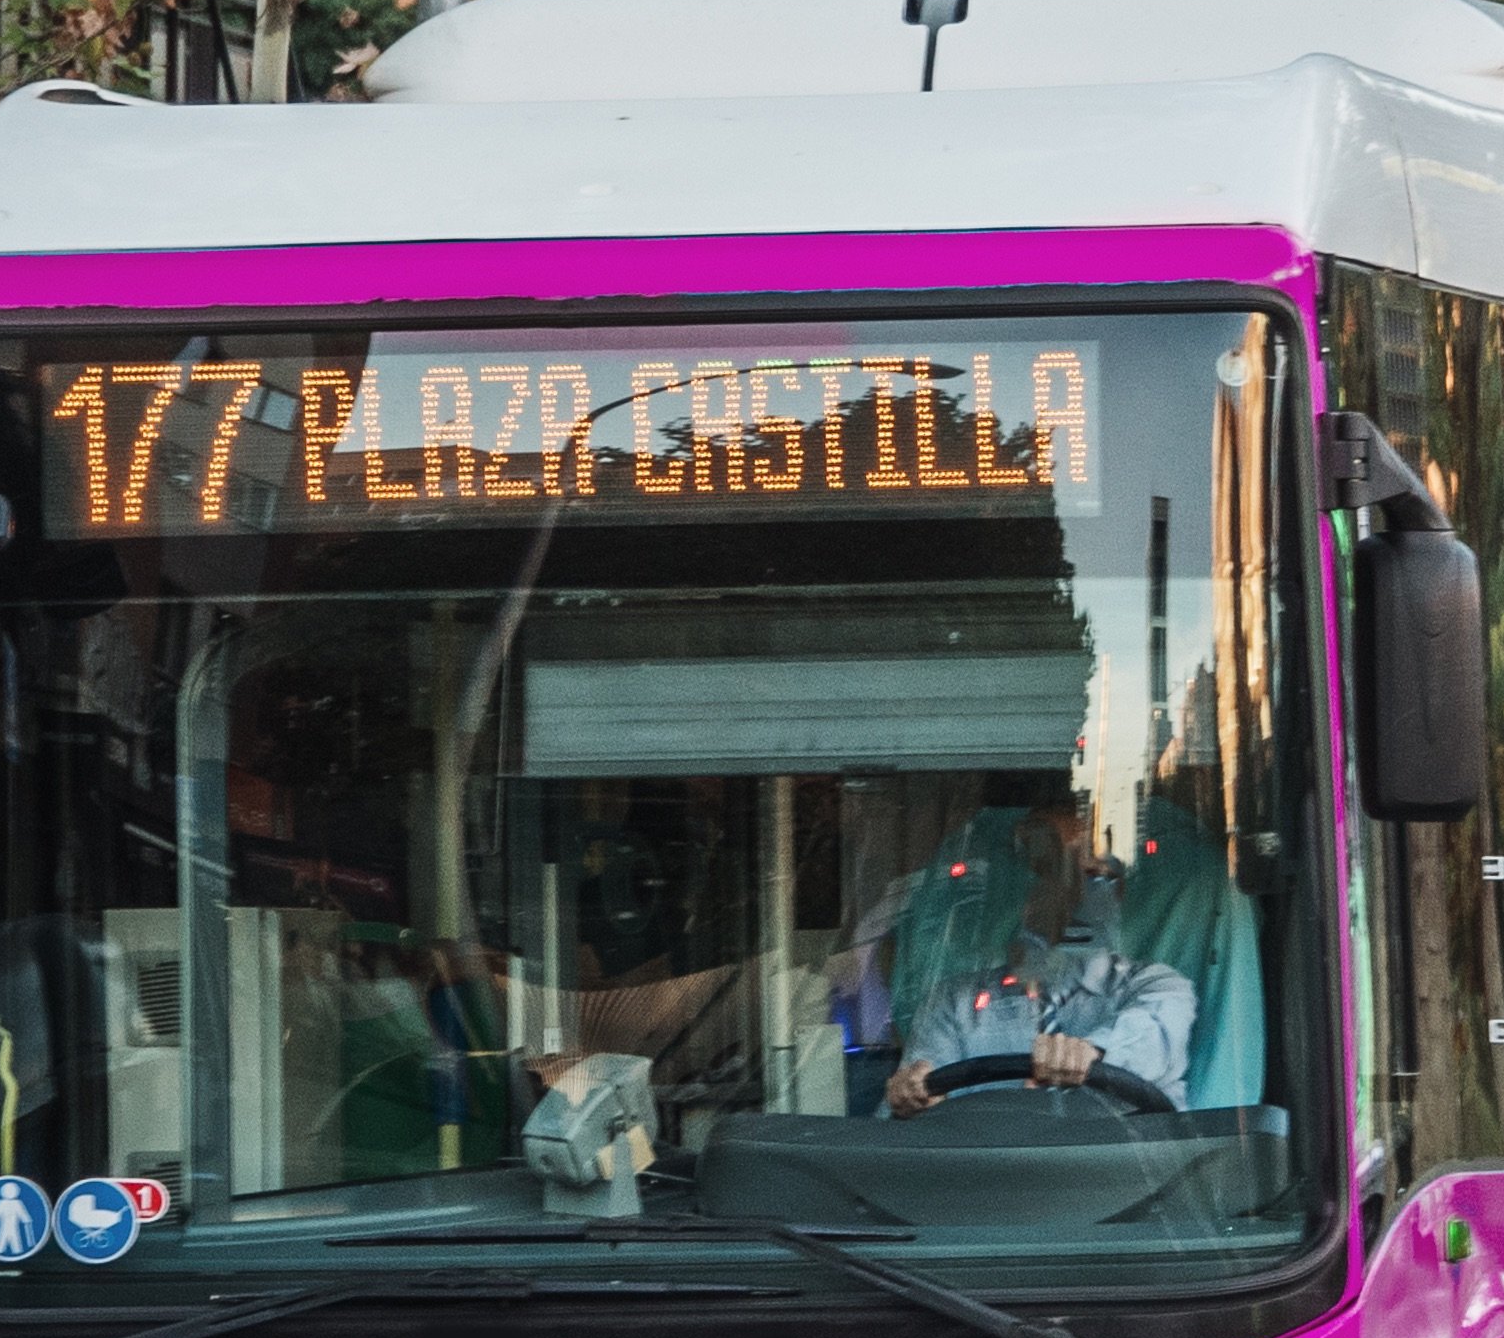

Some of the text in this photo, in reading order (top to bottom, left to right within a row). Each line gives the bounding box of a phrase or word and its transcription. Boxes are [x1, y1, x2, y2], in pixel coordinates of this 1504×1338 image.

[53, 351, 1088, 522] 177 PLAZA CASTILLA
[136, 1185, 152, 1210] 1
